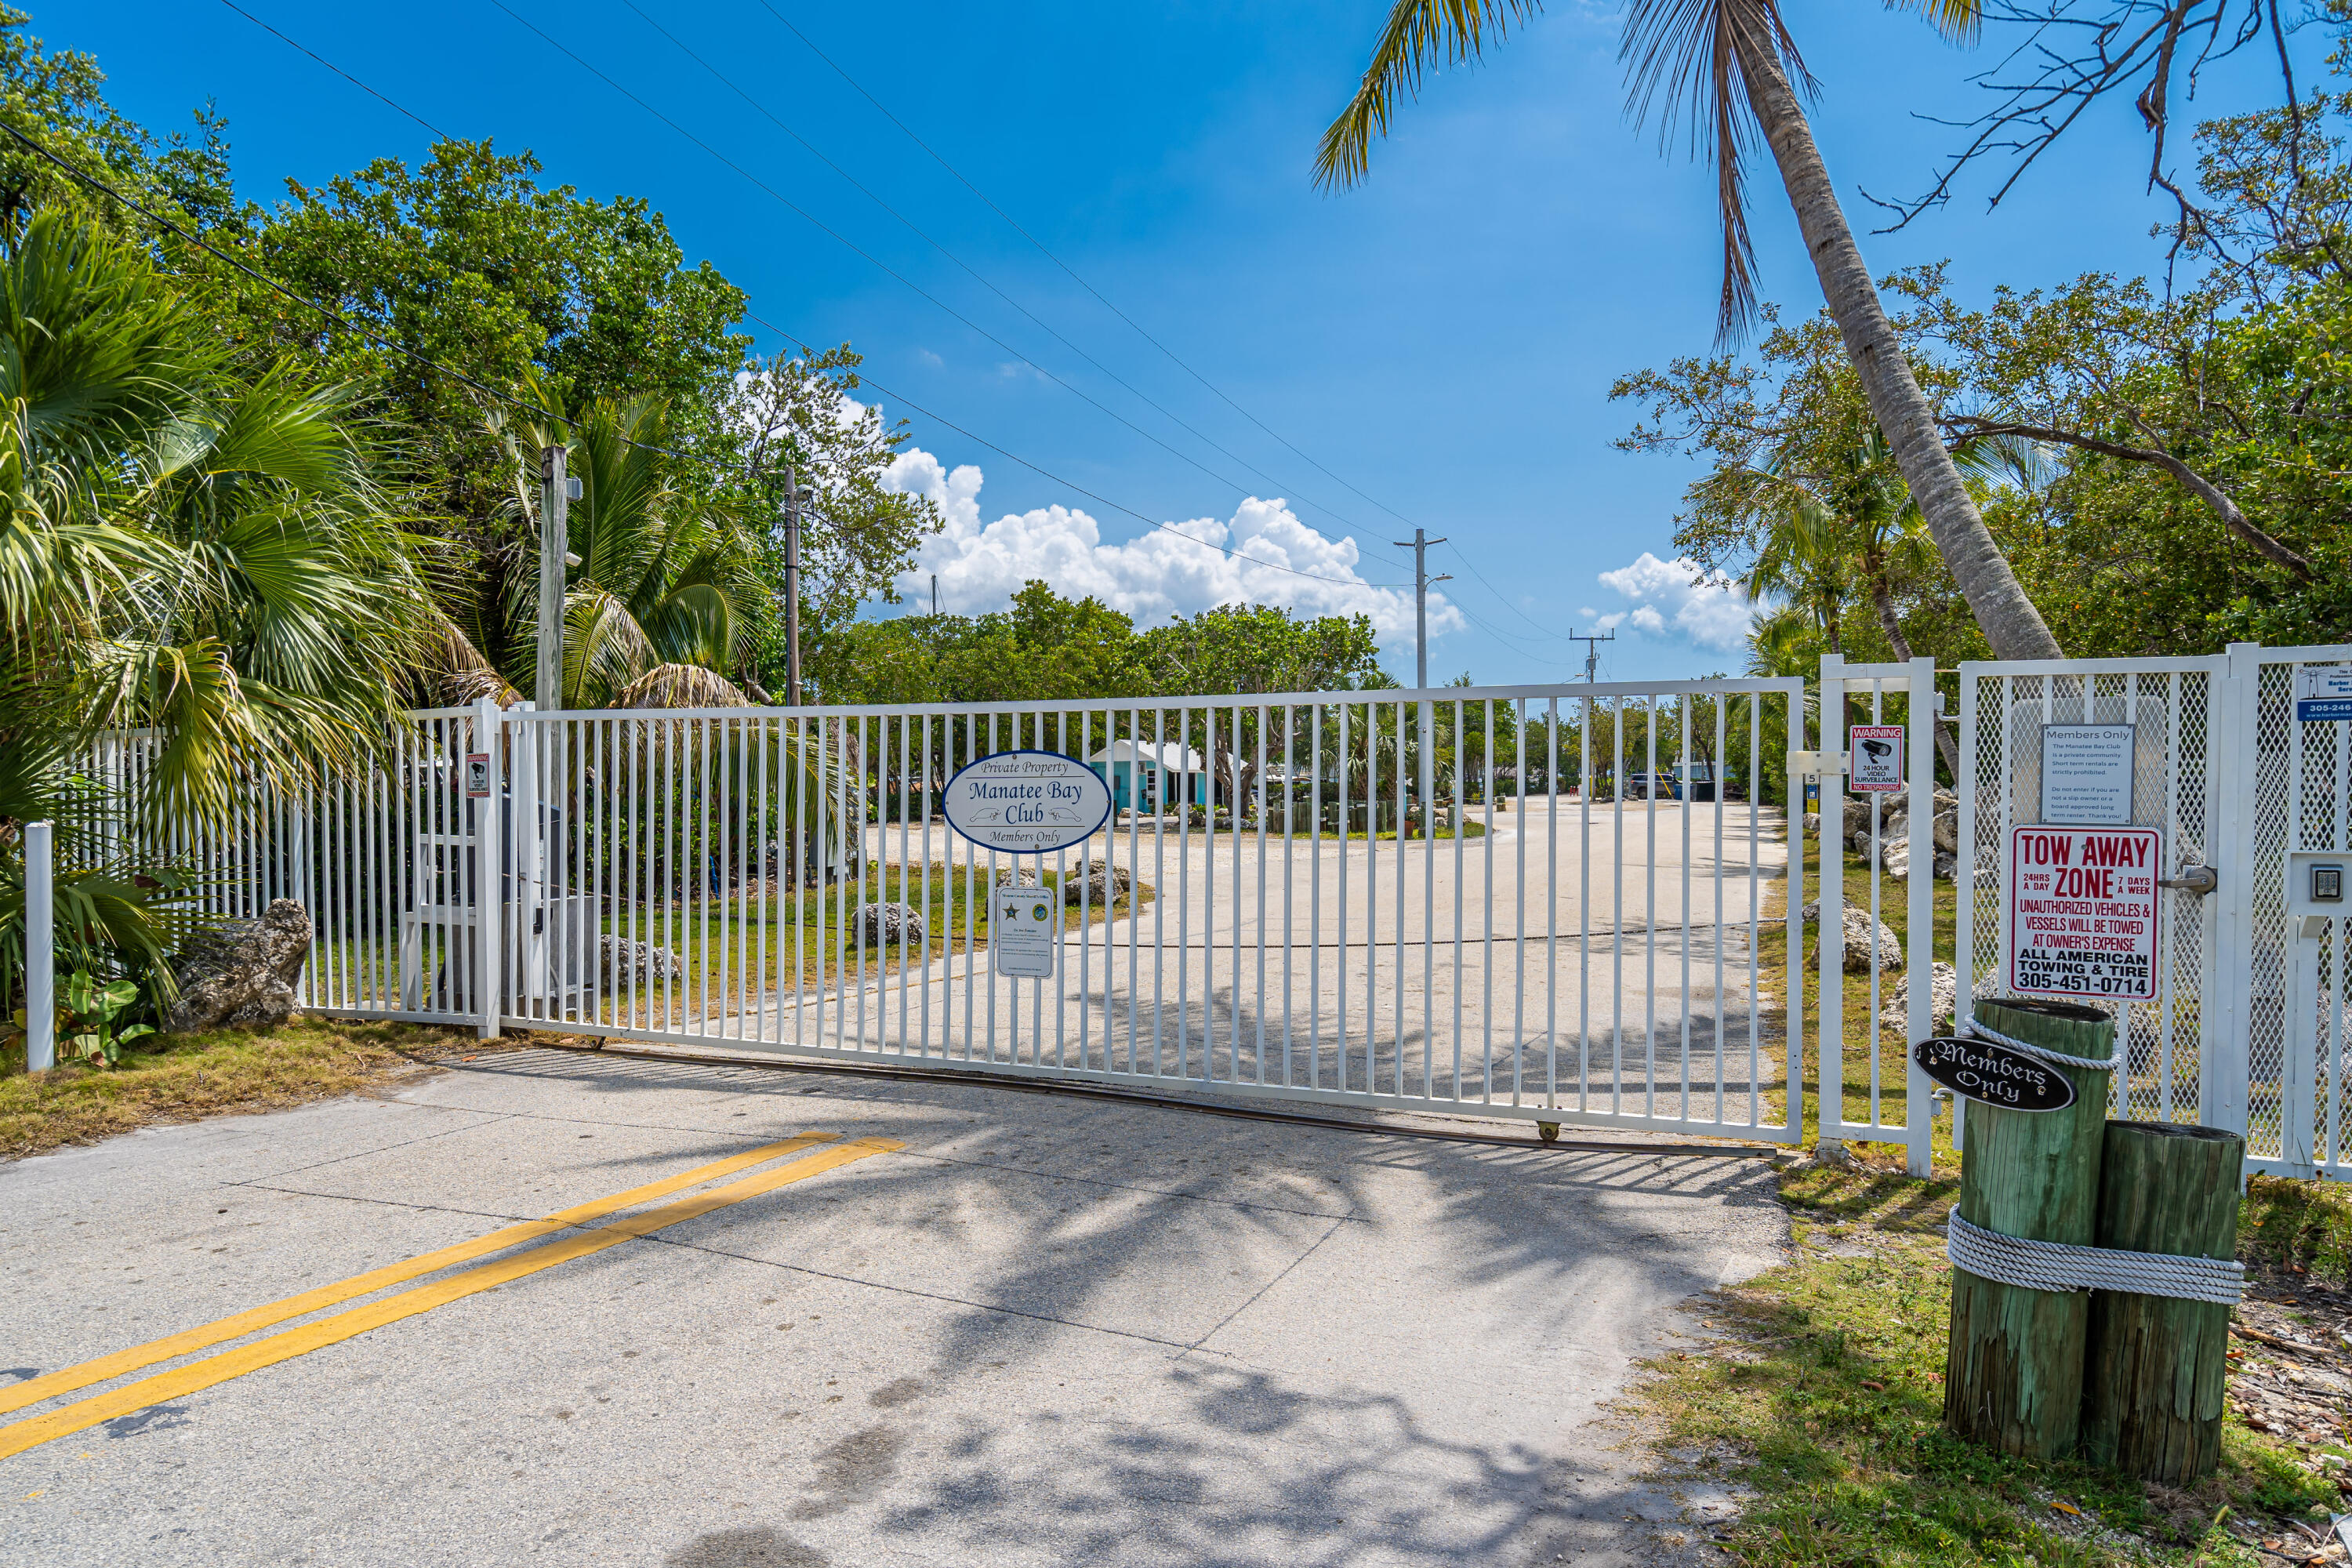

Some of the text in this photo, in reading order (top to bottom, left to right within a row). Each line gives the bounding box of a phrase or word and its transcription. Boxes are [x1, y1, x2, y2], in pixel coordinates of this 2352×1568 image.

[1853, 728, 1901, 738] WARNING
[2046, 731, 2130, 740] Members Only
[981, 761, 1068, 776] Private Property
[969, 781, 1082, 804] Manatee Bay
[1005, 803, 1044, 824] Club
[989, 830, 1061, 845] Members Only
[2021, 835, 2150, 868] TOW AWAY
[2024, 873, 2050, 882] 24HRS
[2054, 867, 2114, 899] ZONE
[2118, 877, 2151, 886] 7 DAYS
[2128, 886, 2151, 895] WEEK
[2020, 899, 2151, 918] UNAUTHORIZED VEHICLES &
[2026, 916, 2143, 935] VESSELS WILL BE TOWED
[2032, 934, 2136, 952] AT OWNER'S EXPENSE
[2020, 949, 2148, 966] ALL AMERICAN
[2018, 960, 2149, 978] TOWING & TIRE
[2019, 972, 2147, 995] 305-451-0714
[1936, 1040, 2046, 1086] Members
[1956, 1070, 2020, 1102] Only
